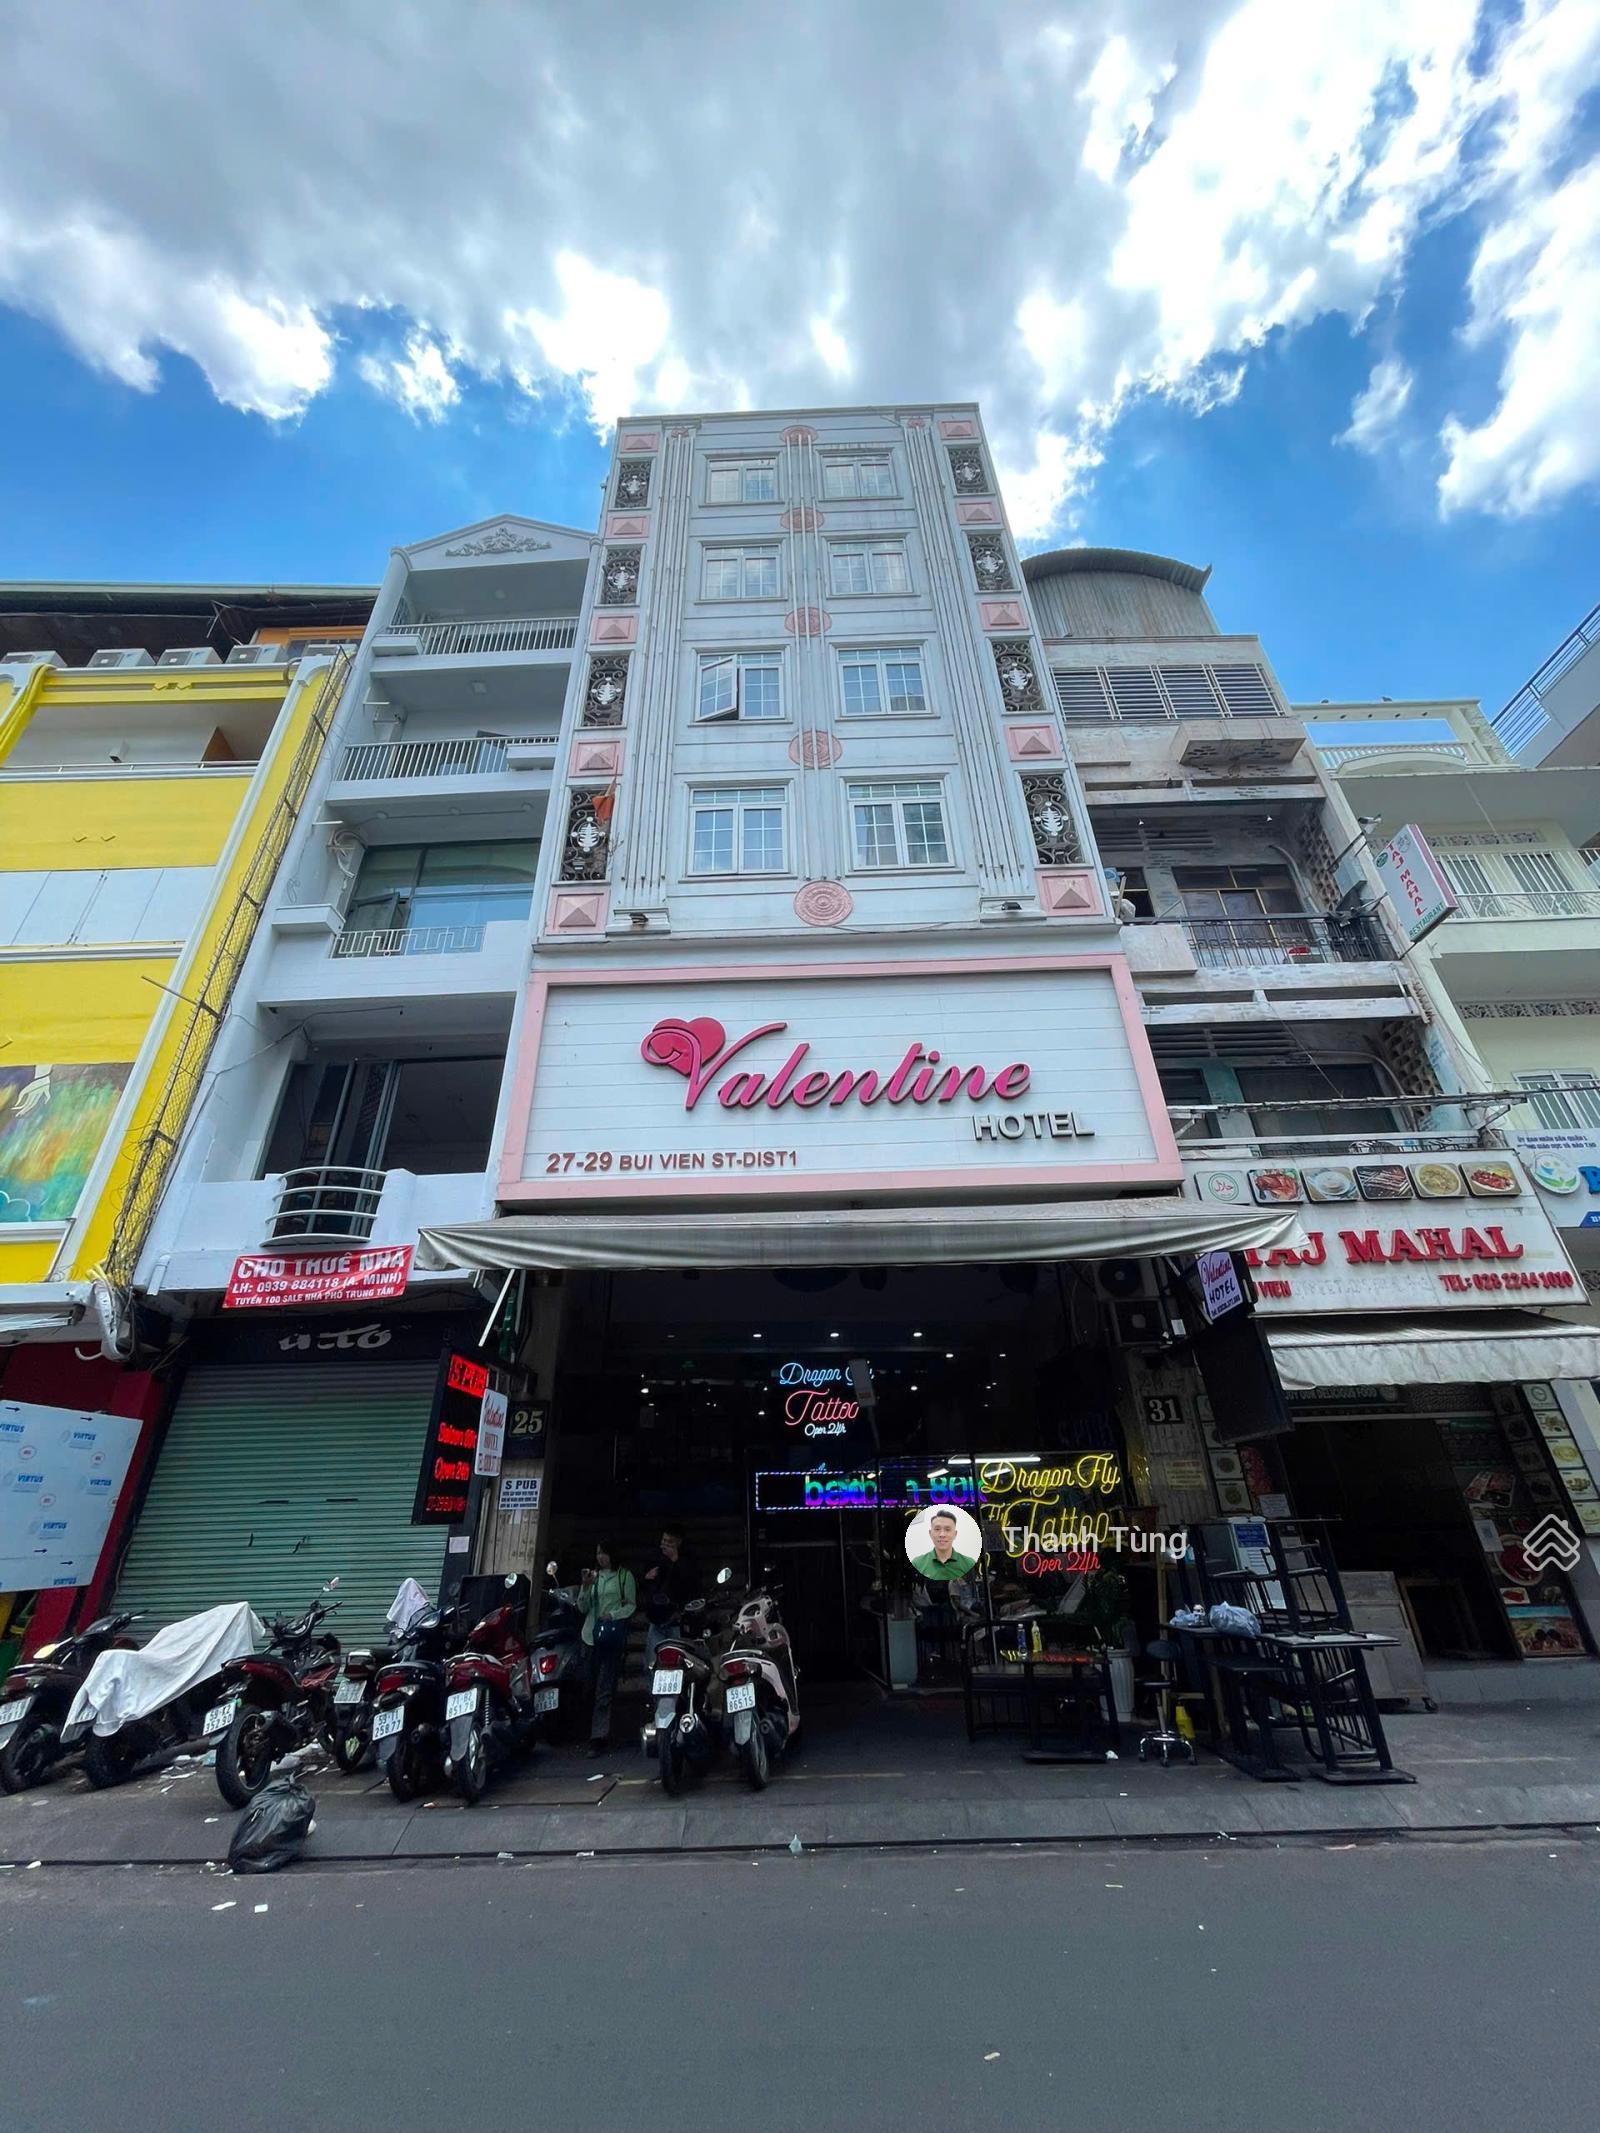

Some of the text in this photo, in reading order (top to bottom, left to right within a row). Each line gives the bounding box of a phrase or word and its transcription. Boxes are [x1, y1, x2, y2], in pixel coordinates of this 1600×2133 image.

[1386, 843, 1428, 917] TAJ MAHAL
[1408, 902, 1444, 938] RESTAURANT
[640, 1022, 1031, 1111] Valentine
[973, 1111, 1095, 1140] HOTEL
[546, 1151, 798, 1173] 27-29 BUI VIEN ST-DIST1
[1338, 1226, 1525, 1264] MAHAL
[237, 1258, 286, 1279] CHO
[294, 1252, 350, 1276] THUÊ
[232, 1282, 252, 1294] LH:
[256, 1281, 287, 1293] 0939
[291, 1278, 340, 1291] 884118
[363, 1272, 402, 1286] MINH)
[1209, 1278, 1236, 1304] HOTEL
[1258, 1280, 1293, 1298] VIEN
[265, 1296, 280, 1304] 100
[282, 1294, 303, 1303] SALE
[346, 1288, 374, 1298] TRUNG
[780, 1362, 842, 1387] Dragon
[785, 1389, 860, 1426] Tattoo
[1148, 1399, 1182, 1423] 31
[512, 1411, 543, 1435] 25
[73, 1431, 96, 1441] VIRTUS
[17, 1474, 43, 1483] VIRTUS
[90, 1478, 112, 1487] VIRTUS
[505, 1480, 537, 1490] S PUB
[980, 1458, 1076, 1497] Dragon
[1077, 1453, 1121, 1494] Fly
[43, 1521, 68, 1530] VIRTUS
[1001, 1494, 1110, 1558] Tattoo
[1023, 1551, 1100, 1578] Open 24h
